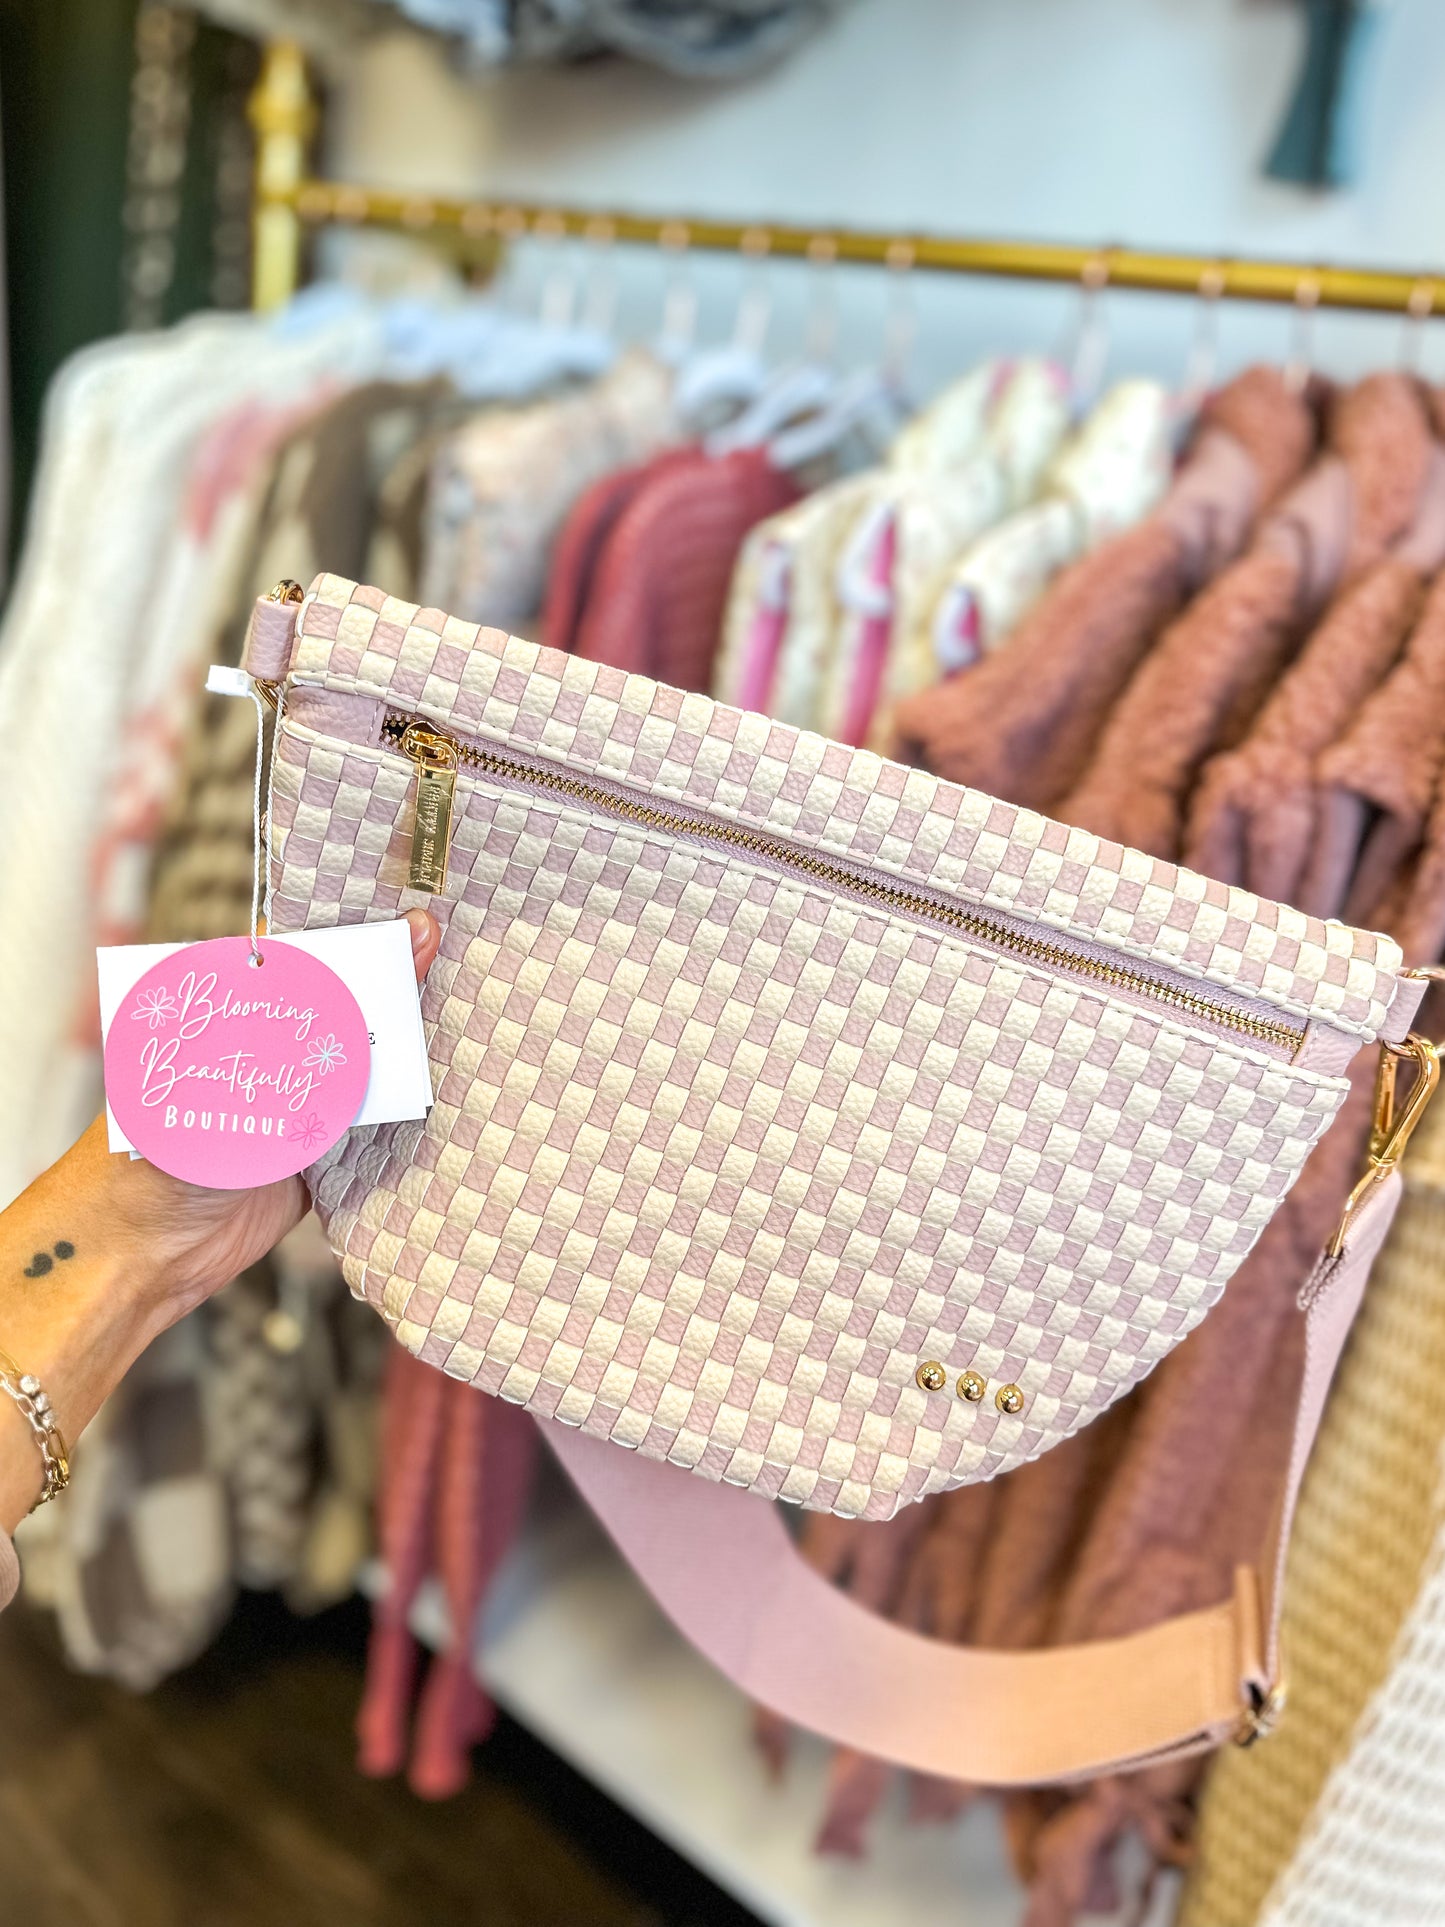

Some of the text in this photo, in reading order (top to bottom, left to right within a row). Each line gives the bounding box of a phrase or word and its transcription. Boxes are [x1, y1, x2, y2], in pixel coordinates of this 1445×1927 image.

[178, 971, 319, 1040] Blooming
[140, 1037, 321, 1112] Beautifully
[164, 1105, 286, 1137] BOUTIQUE
